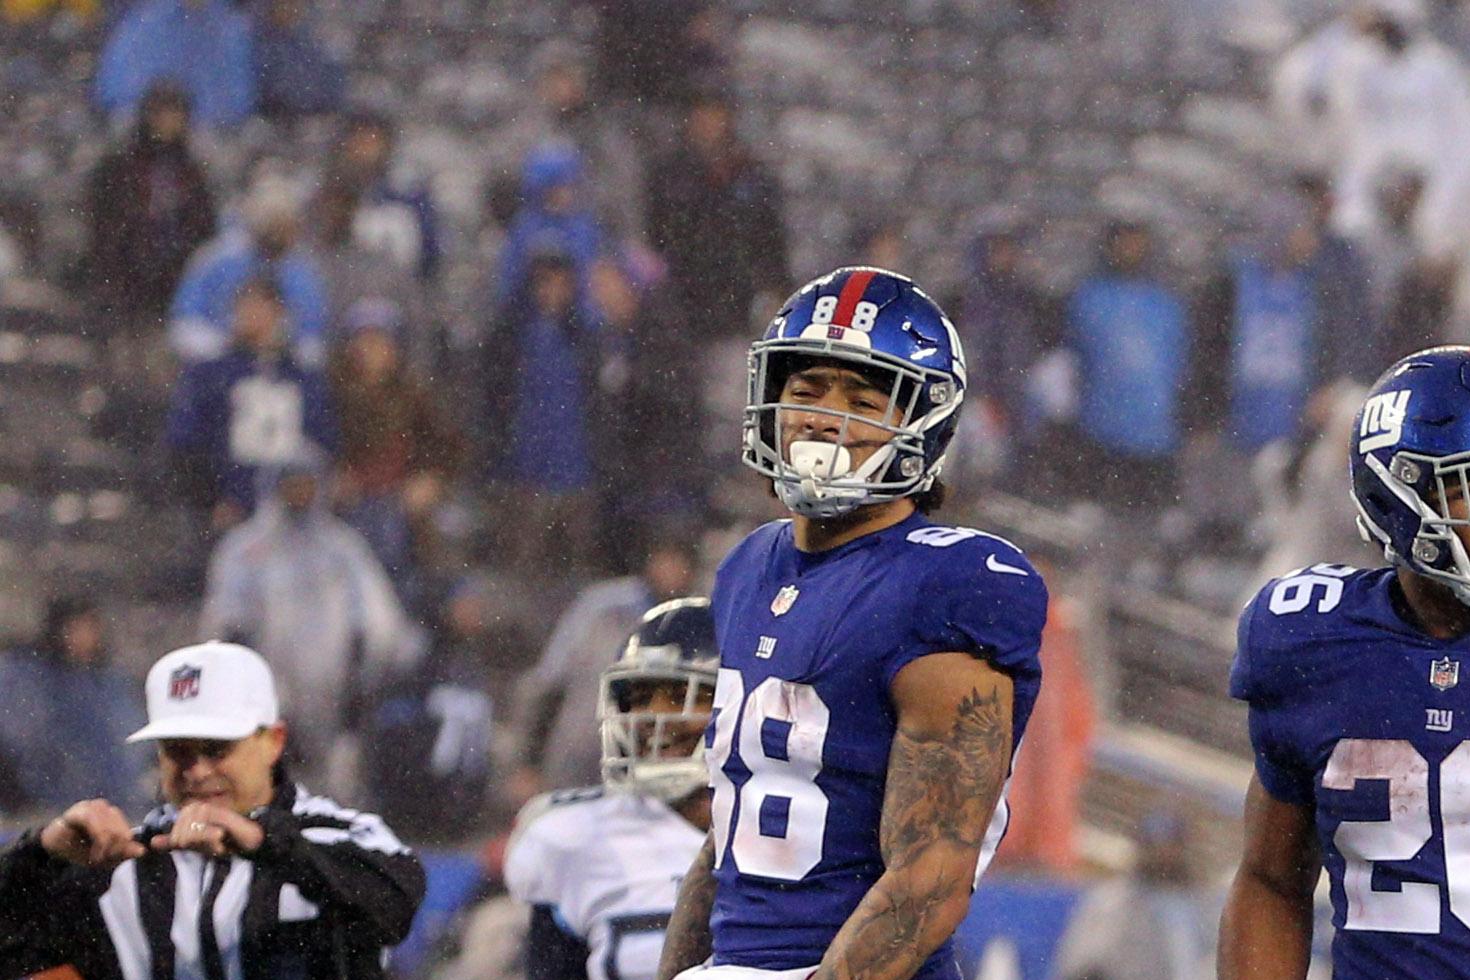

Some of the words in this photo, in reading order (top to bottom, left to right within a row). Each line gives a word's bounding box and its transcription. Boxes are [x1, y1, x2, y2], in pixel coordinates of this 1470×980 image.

[812, 295, 878, 332] 88
[1359, 391, 1411, 454] ny
[1425, 708, 1453, 731] ny
